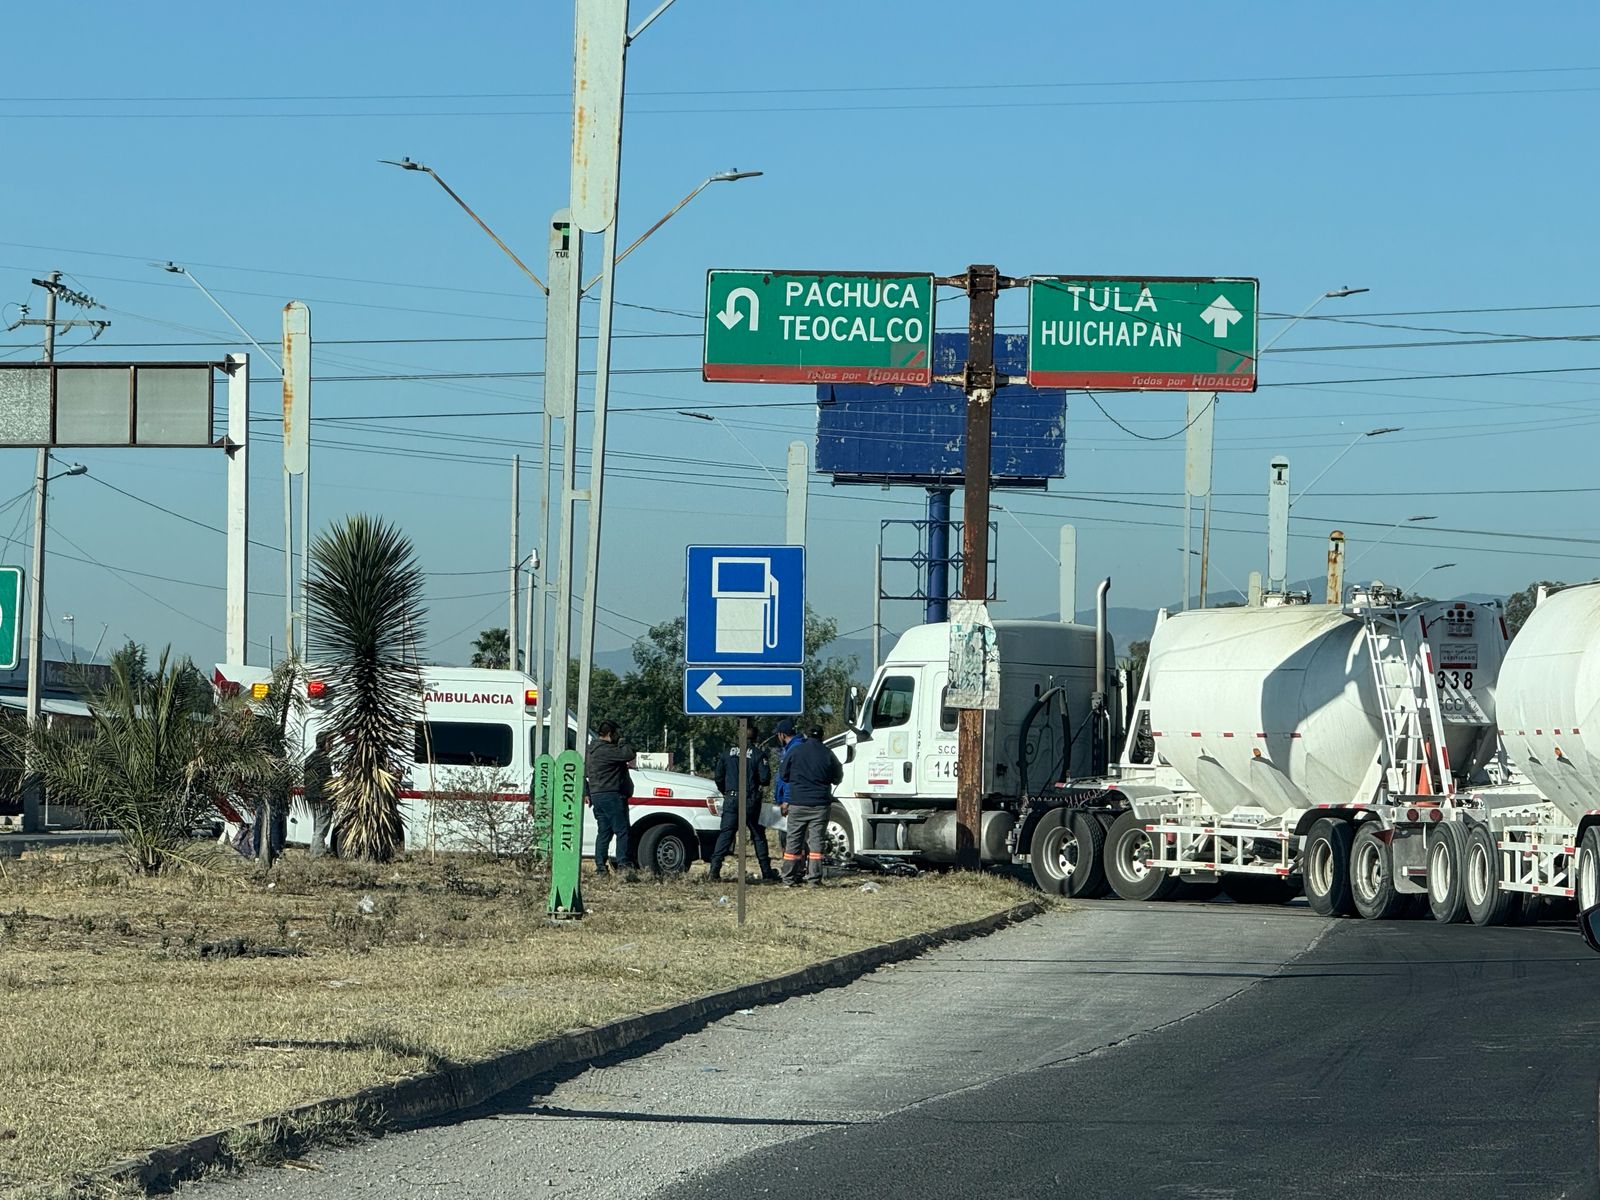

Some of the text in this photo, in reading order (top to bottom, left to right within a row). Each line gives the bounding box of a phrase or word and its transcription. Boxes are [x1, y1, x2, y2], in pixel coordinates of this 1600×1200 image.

[555, 251, 570, 259] TUL
[786, 281, 919, 308] PACHUCA
[1068, 286, 1158, 312] TULA
[779, 315, 923, 343] TEOCALCO
[1041, 320, 1182, 348] HUICHAPAN
[842, 372, 861, 381] por
[867, 369, 925, 382] HIDALGO
[1131, 374, 1249, 387] Todos por HIDALGO
[1437, 670, 1473, 690] 338
[424, 692, 514, 705] AMBULANCIA
[561, 763, 577, 851] 2016-2020
